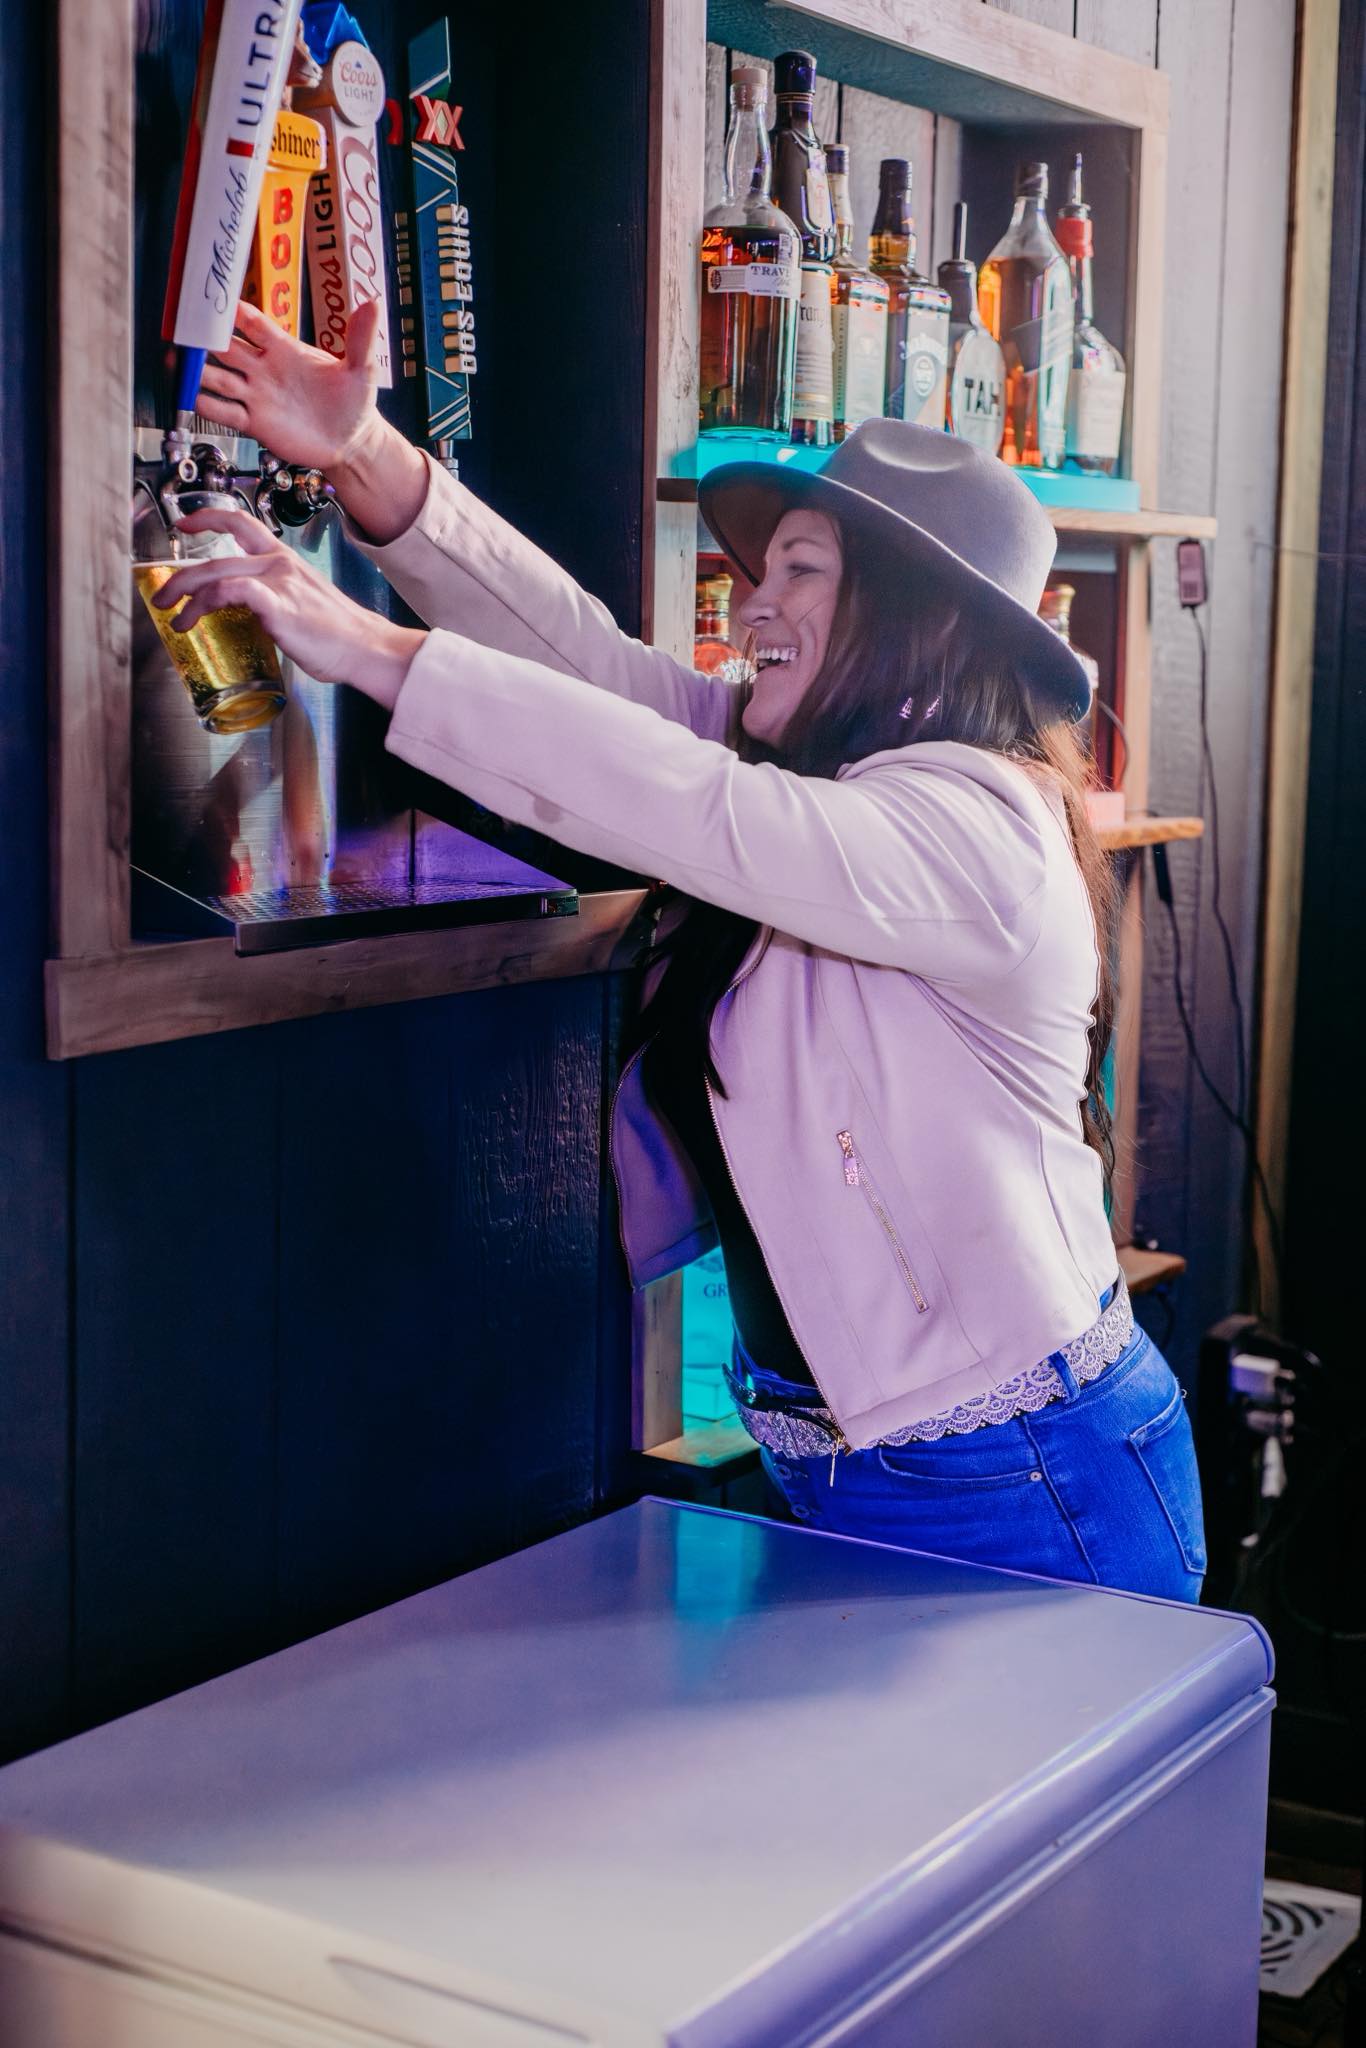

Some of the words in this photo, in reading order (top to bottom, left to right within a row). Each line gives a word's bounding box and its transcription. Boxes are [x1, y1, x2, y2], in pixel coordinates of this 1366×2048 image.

[237, 0, 283, 126] ULTR
[204, 165, 248, 315] Michelob
[270, 187, 293, 333] BOC
[311, 172, 337, 252] LIGH
[340, 136, 384, 341] Coor
[446, 203, 474, 303] EQUIS
[319, 255, 347, 361] Coors
[454, 311, 478, 375] DOS
[703, 1283, 727, 1298] GR
